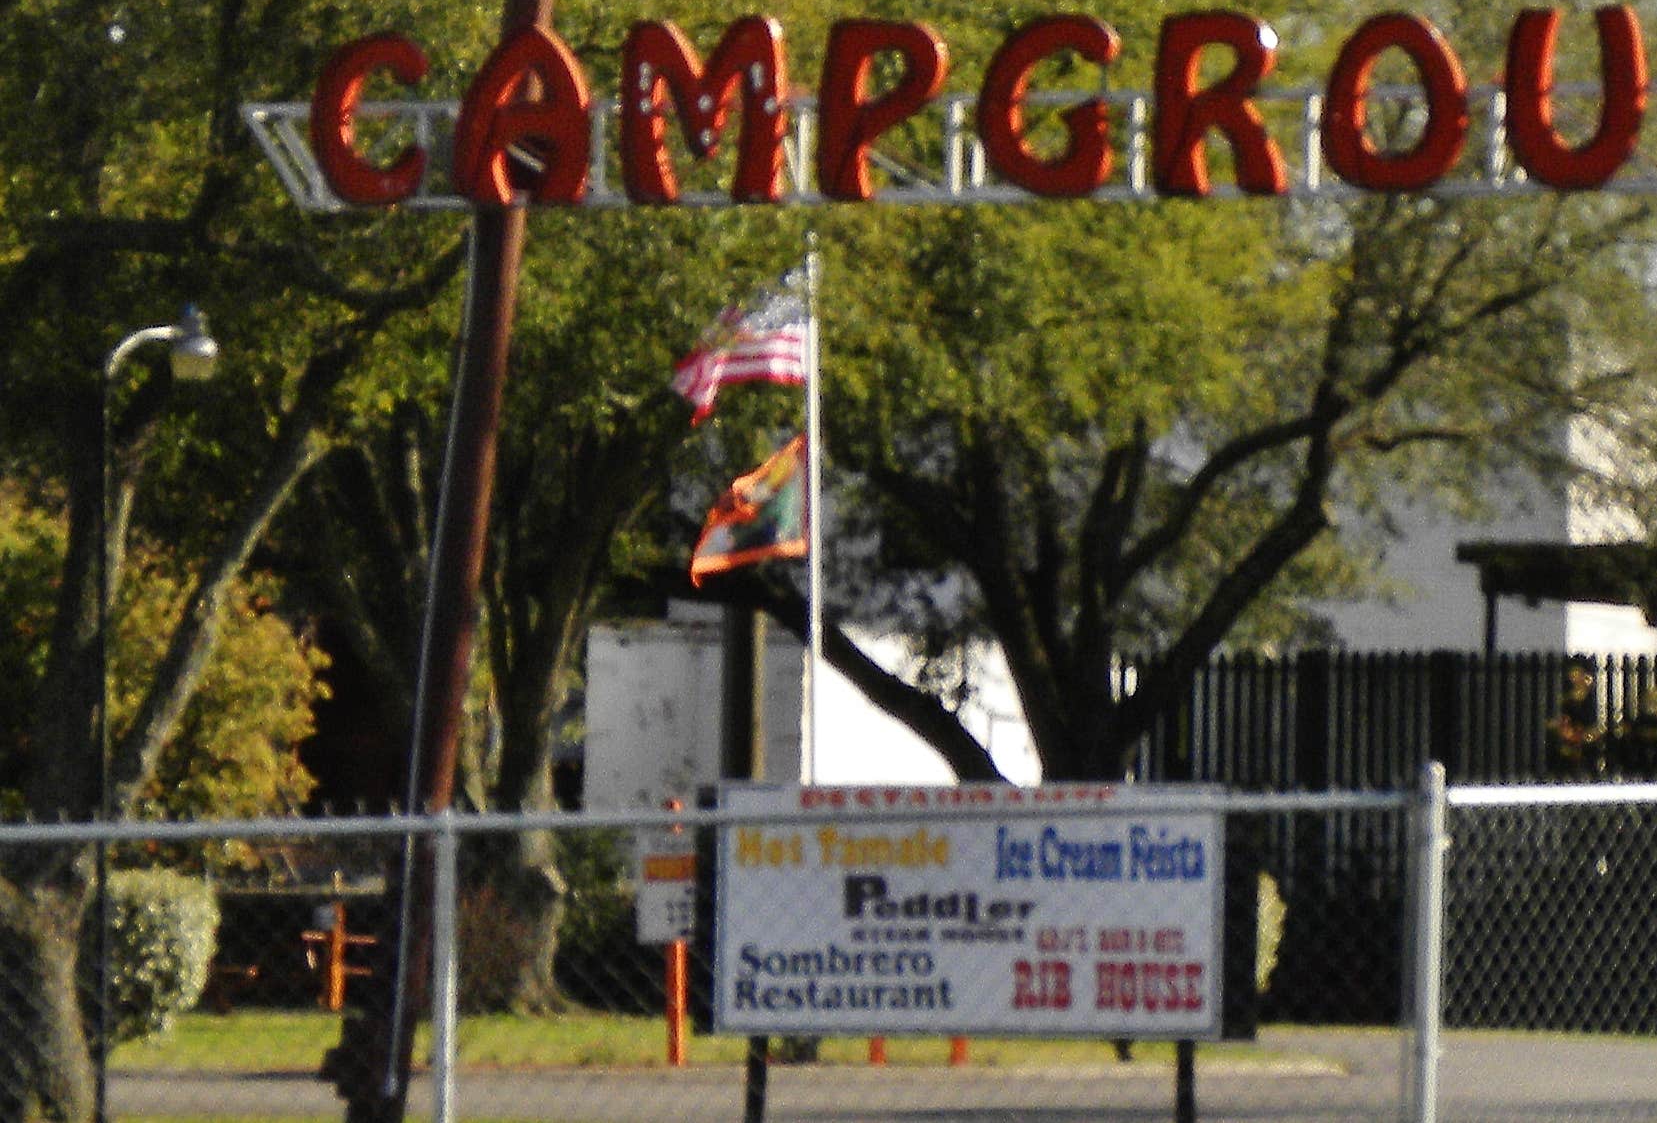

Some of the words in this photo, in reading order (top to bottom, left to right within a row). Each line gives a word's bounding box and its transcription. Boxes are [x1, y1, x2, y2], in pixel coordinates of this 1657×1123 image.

[737, 827, 803, 867] Hot
[818, 825, 950, 867] Tamale
[996, 825, 1033, 880] Ice
[1039, 825, 1122, 880] Cream
[739, 943, 936, 977] Sombrero
[734, 977, 953, 1011] Restaurant
[1012, 959, 1072, 1011] RIB
[1096, 960, 1203, 1012] HOUSE
